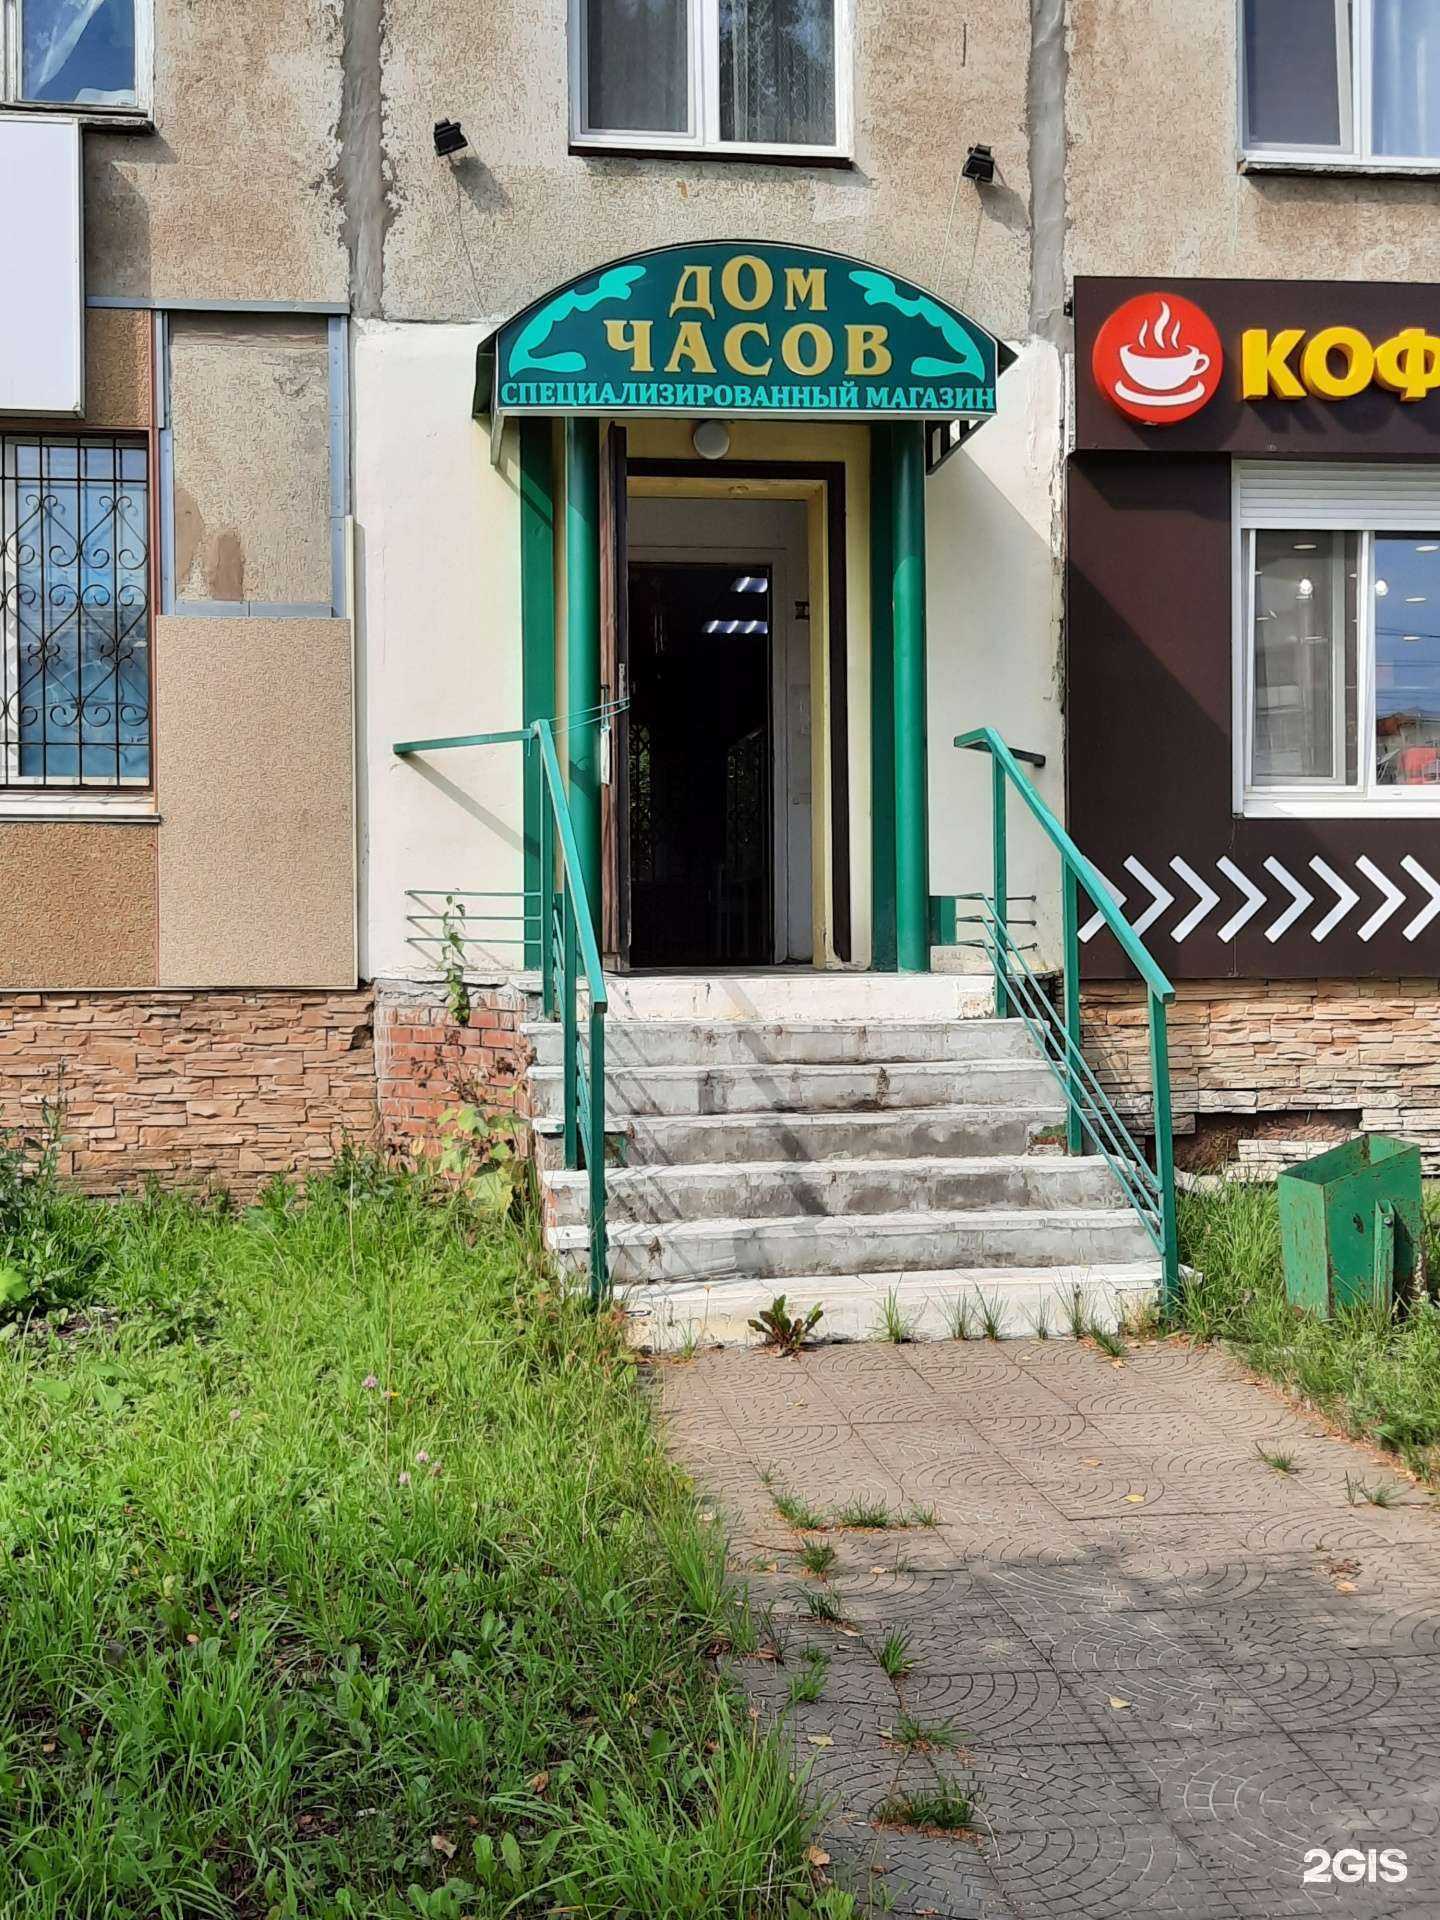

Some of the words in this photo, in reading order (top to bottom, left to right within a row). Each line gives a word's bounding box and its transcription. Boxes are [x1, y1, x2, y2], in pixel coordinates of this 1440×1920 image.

[669, 255, 828, 319] ДОМ
[603, 320, 893, 376] ЧАСОВ
[1242, 326, 1440, 401] КОФ
[501, 382, 860, 406] СПЕЦИАЛИЗИРОВАННЫЙ
[867, 387, 995, 409] МАГАЗИН
